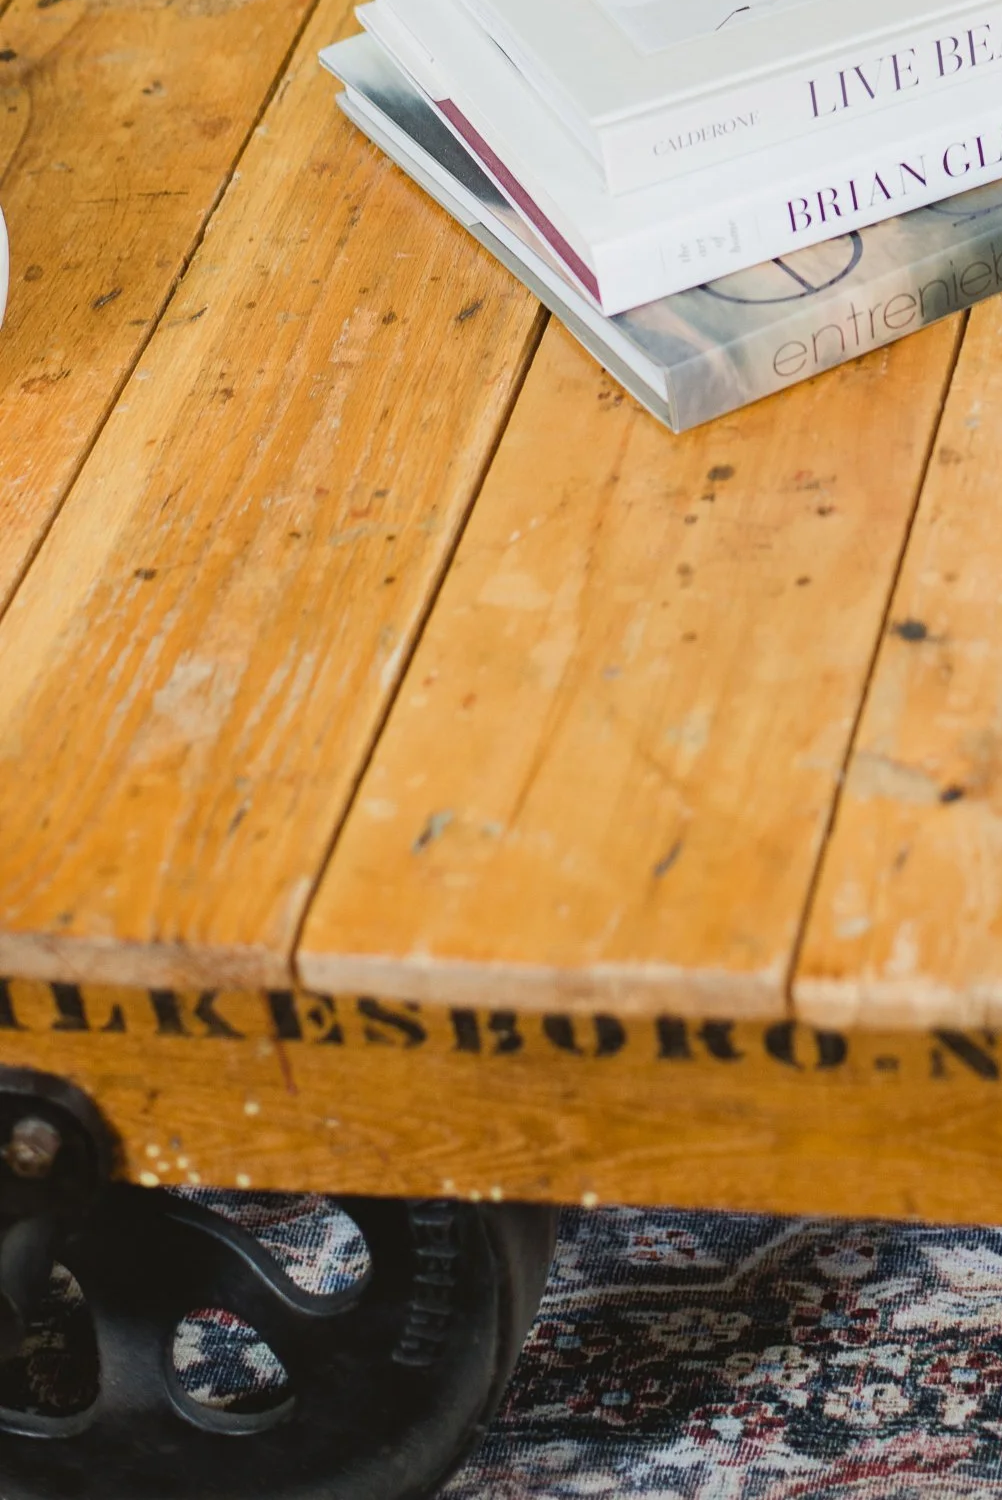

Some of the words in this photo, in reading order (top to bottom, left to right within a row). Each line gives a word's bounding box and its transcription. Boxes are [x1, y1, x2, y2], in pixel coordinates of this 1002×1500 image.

[806, 47, 920, 120] LIVE
[652, 108, 762, 157] CALDERONE
[786, 153, 928, 234] BRIAN
